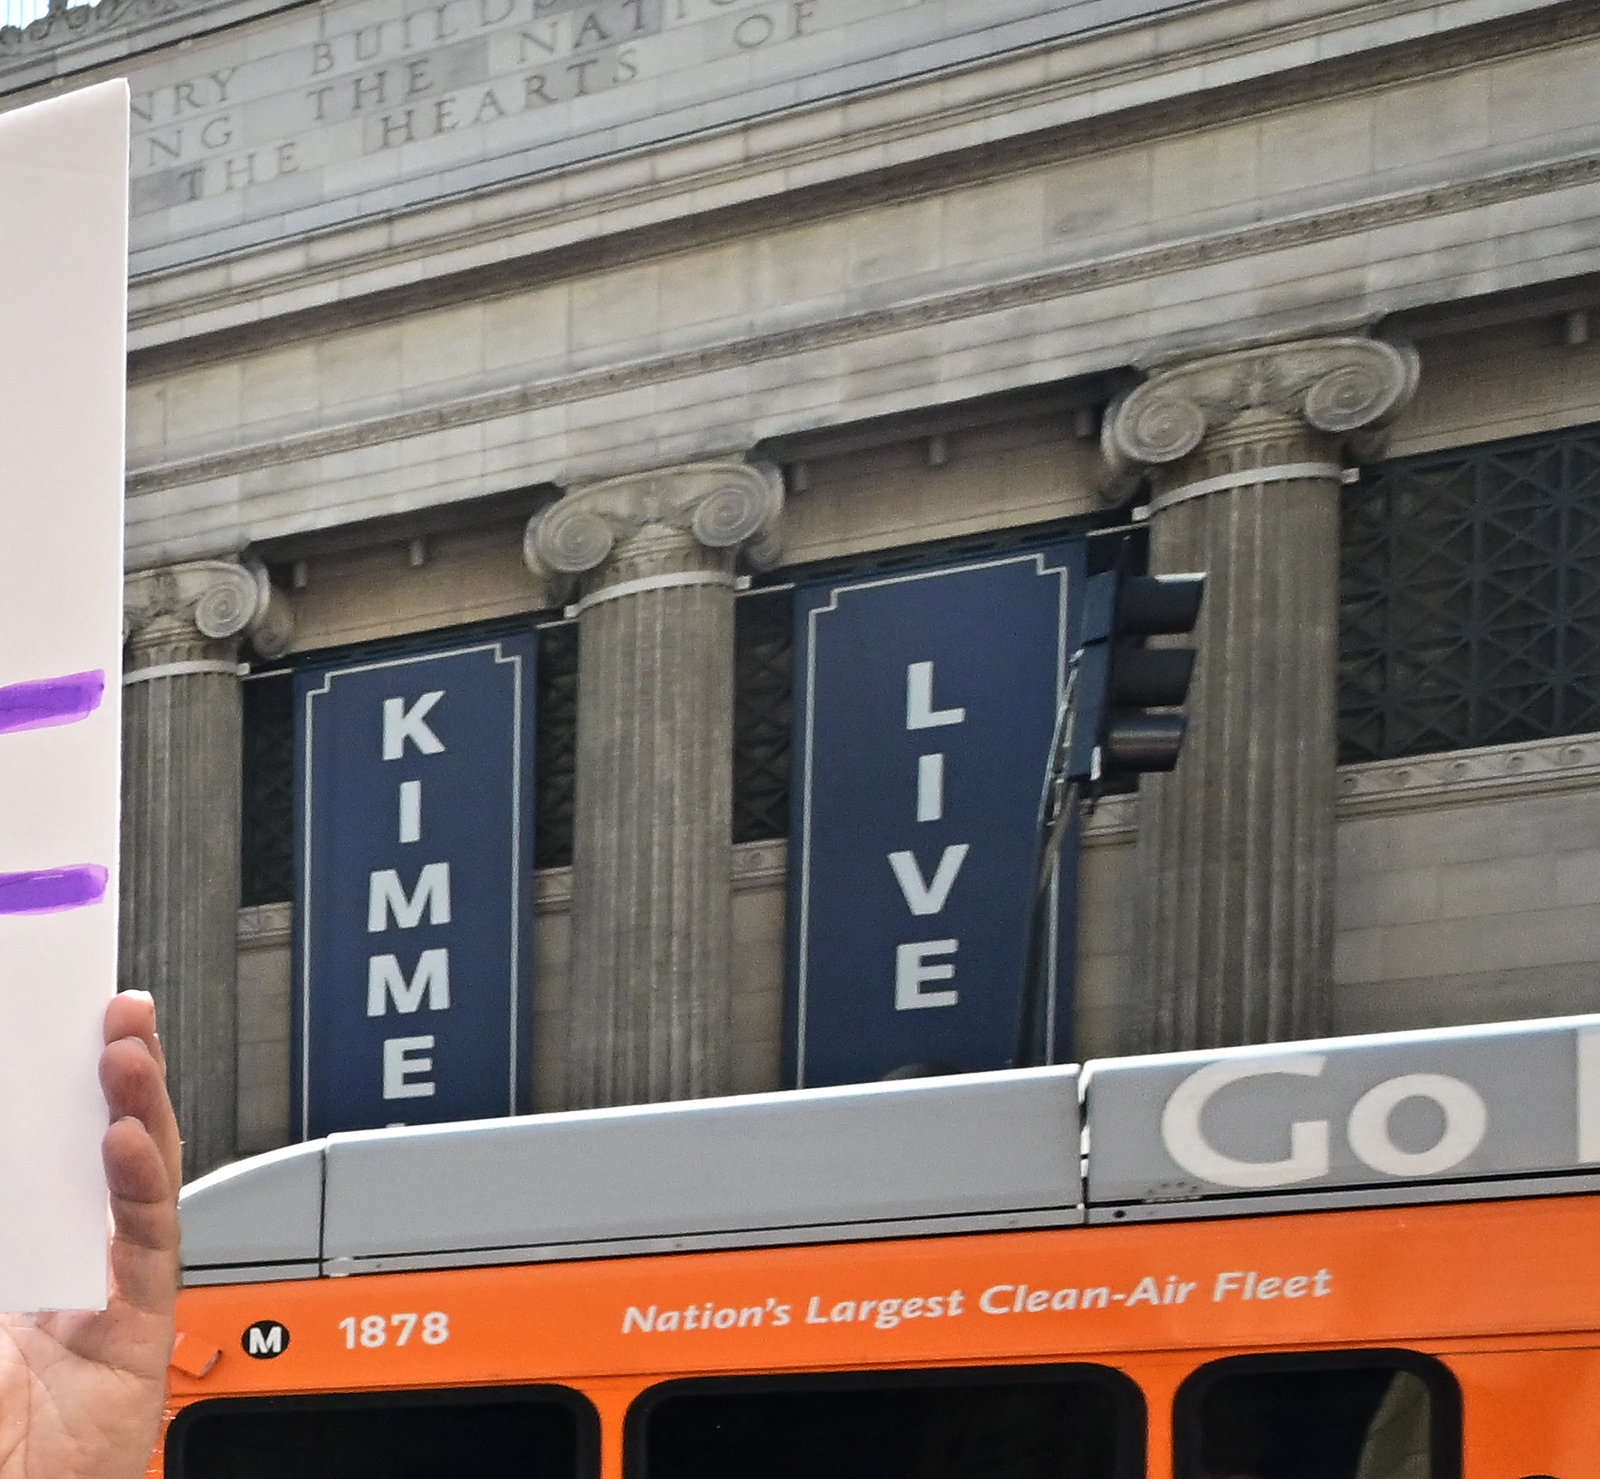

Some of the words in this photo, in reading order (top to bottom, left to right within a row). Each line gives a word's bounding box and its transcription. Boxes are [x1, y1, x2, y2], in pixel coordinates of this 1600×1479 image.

[307, 57, 434, 121] THE
[311, 0, 557, 75] BUILD
[181, 141, 300, 201] THE
[380, 48, 640, 150] HEARTS
[887, 660, 971, 1010] LIVE
[366, 689, 453, 1128] KIMME
[1161, 1052, 1489, 1188] Go
[338, 1311, 450, 1350] 1878
[620, 1298, 791, 1334] Nation's
[804, 1287, 964, 1329] Largest
[978, 1275, 1198, 1317] Clean-Air
[1212, 1268, 1333, 1302] Fleet
